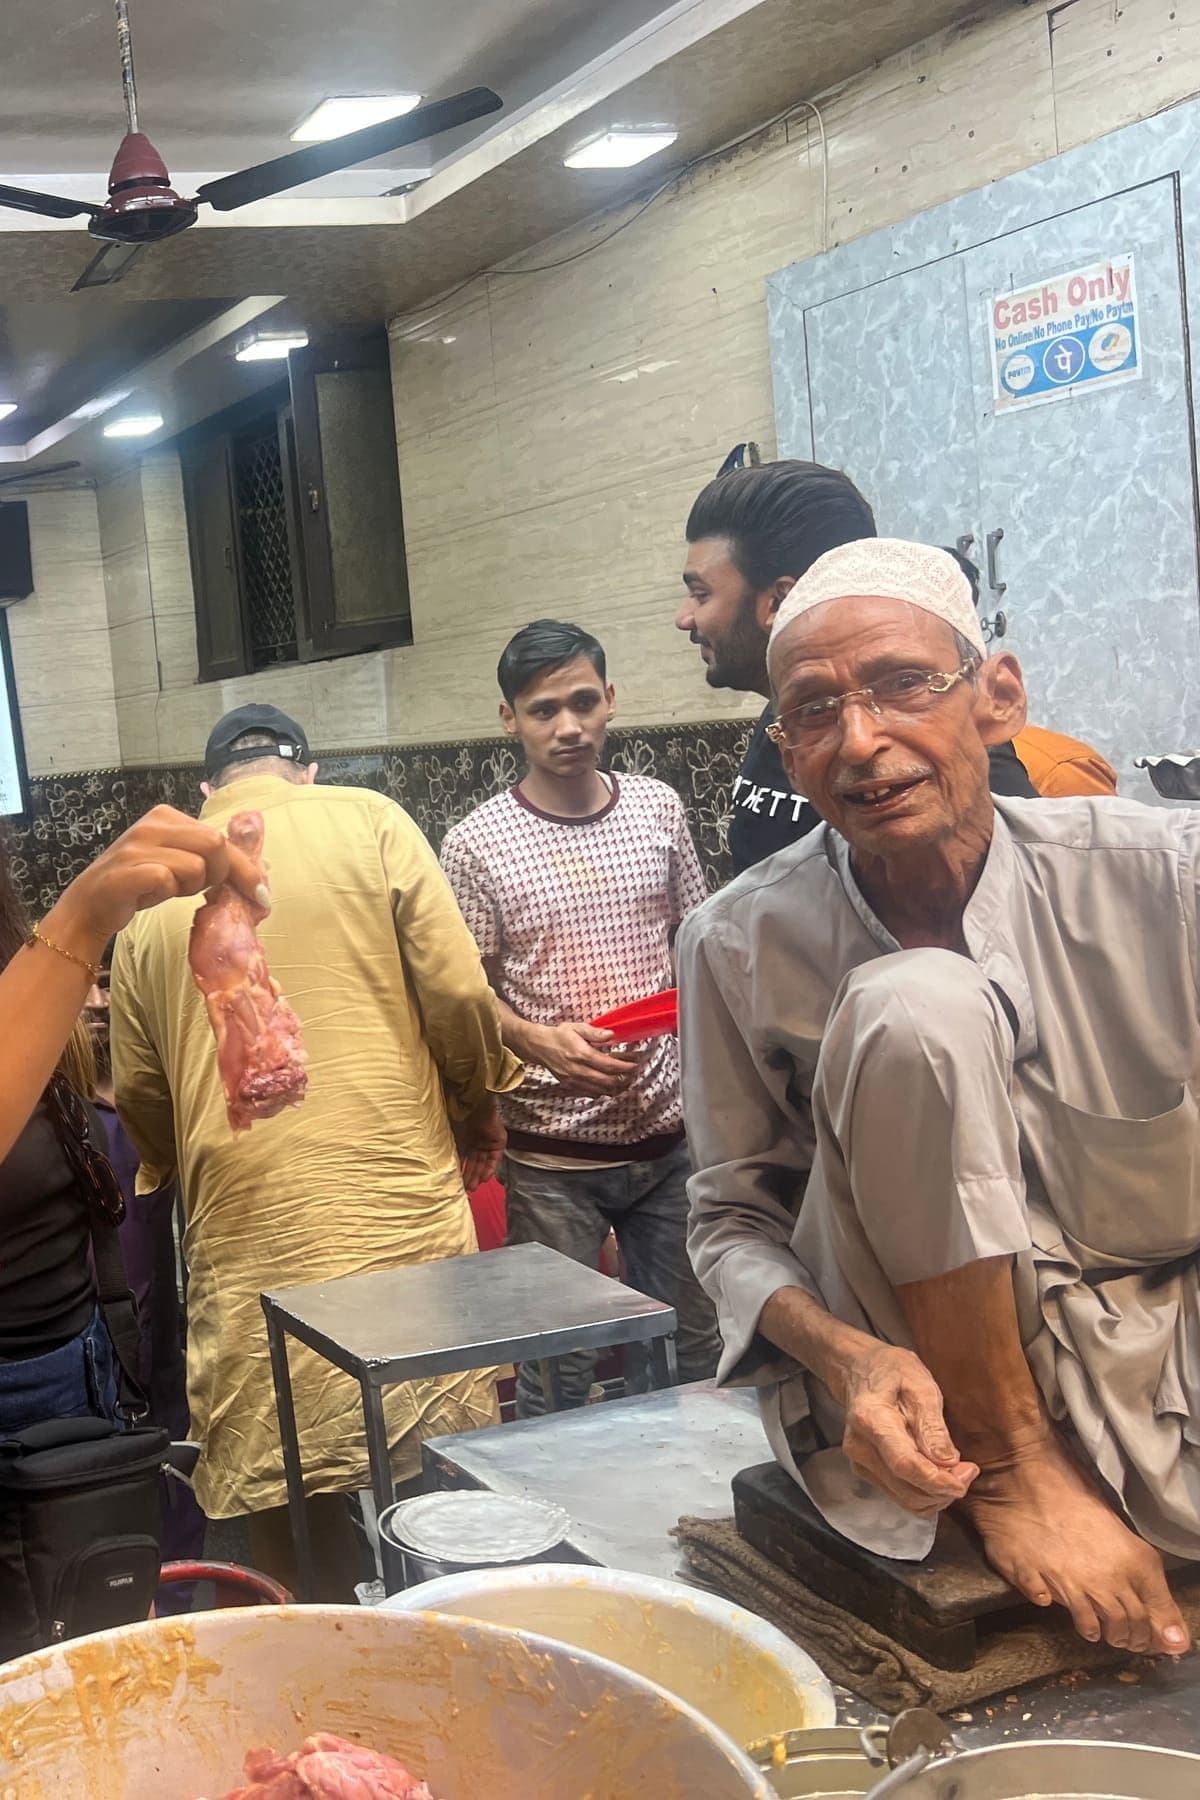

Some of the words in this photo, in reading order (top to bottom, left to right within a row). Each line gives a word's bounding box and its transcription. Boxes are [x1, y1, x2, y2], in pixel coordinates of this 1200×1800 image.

[993, 286, 1058, 330] Cash
[1067, 262, 1130, 306] Only
[1046, 319, 1073, 337] Phone
